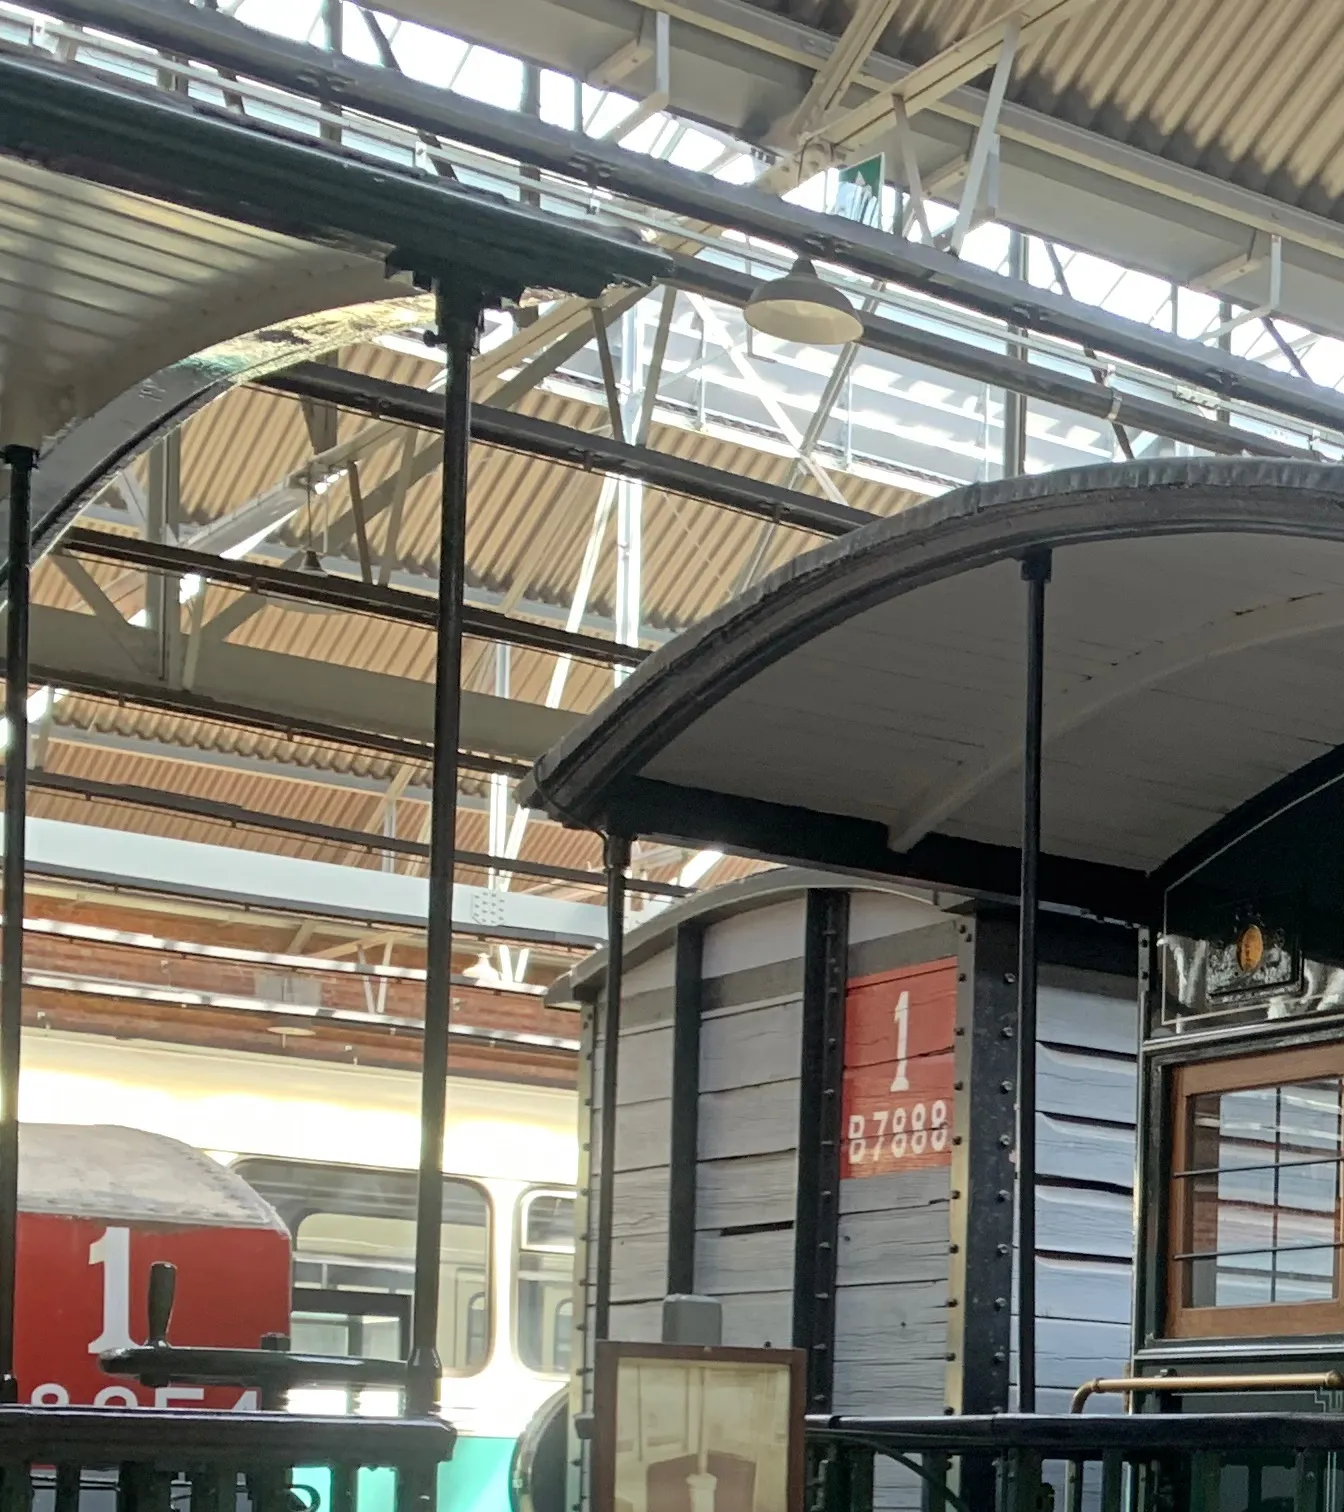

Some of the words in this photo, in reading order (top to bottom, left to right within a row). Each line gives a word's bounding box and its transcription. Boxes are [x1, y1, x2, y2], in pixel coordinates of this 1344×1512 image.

[889, 990, 911, 1093] 1
[848, 1099, 949, 1165] B7888
[87, 1226, 146, 1355] 1
